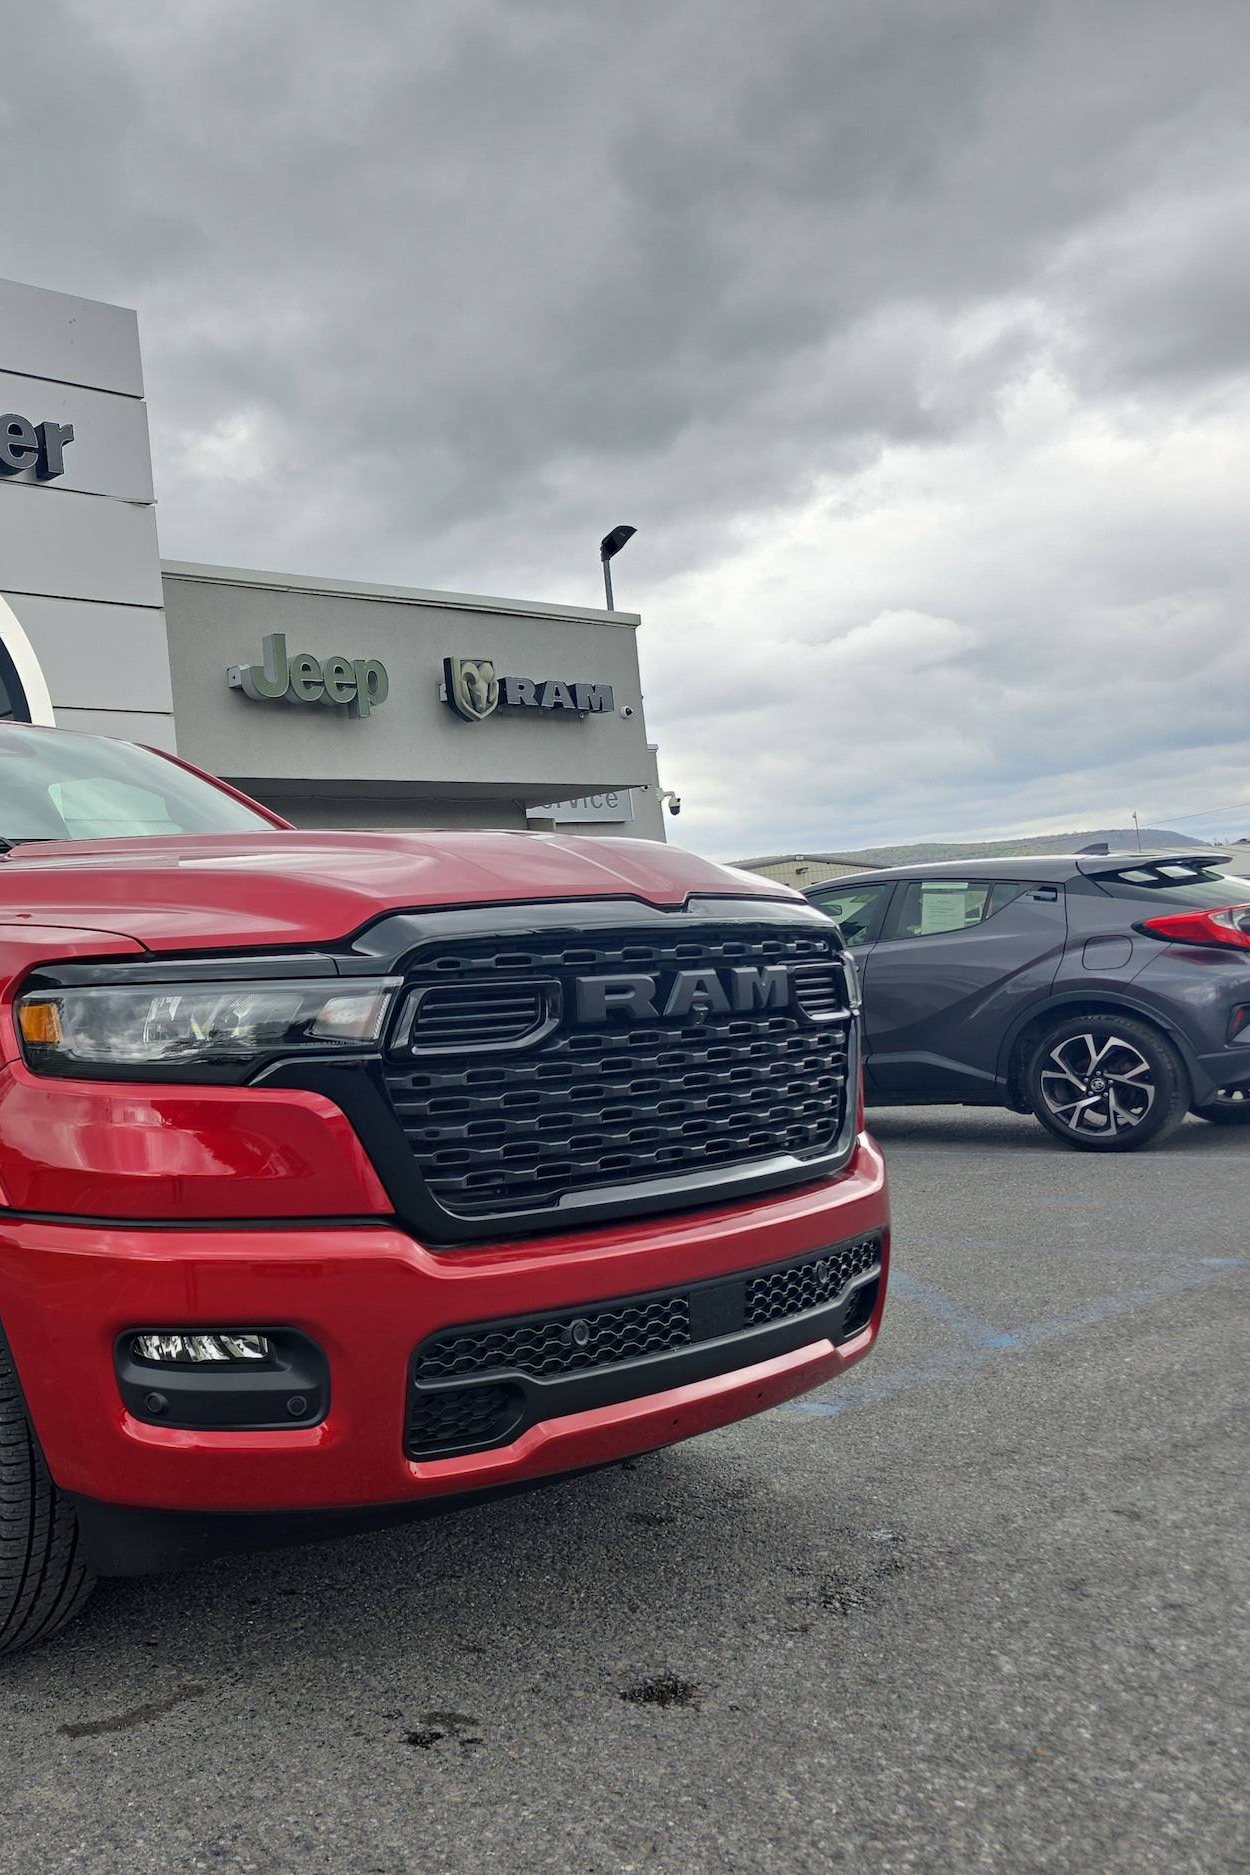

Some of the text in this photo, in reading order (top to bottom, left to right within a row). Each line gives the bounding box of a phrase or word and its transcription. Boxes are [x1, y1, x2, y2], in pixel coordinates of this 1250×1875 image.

[240, 633, 390, 719] Jeep
[501, 676, 615, 714] RAM
[575, 965, 790, 1024] RAM
